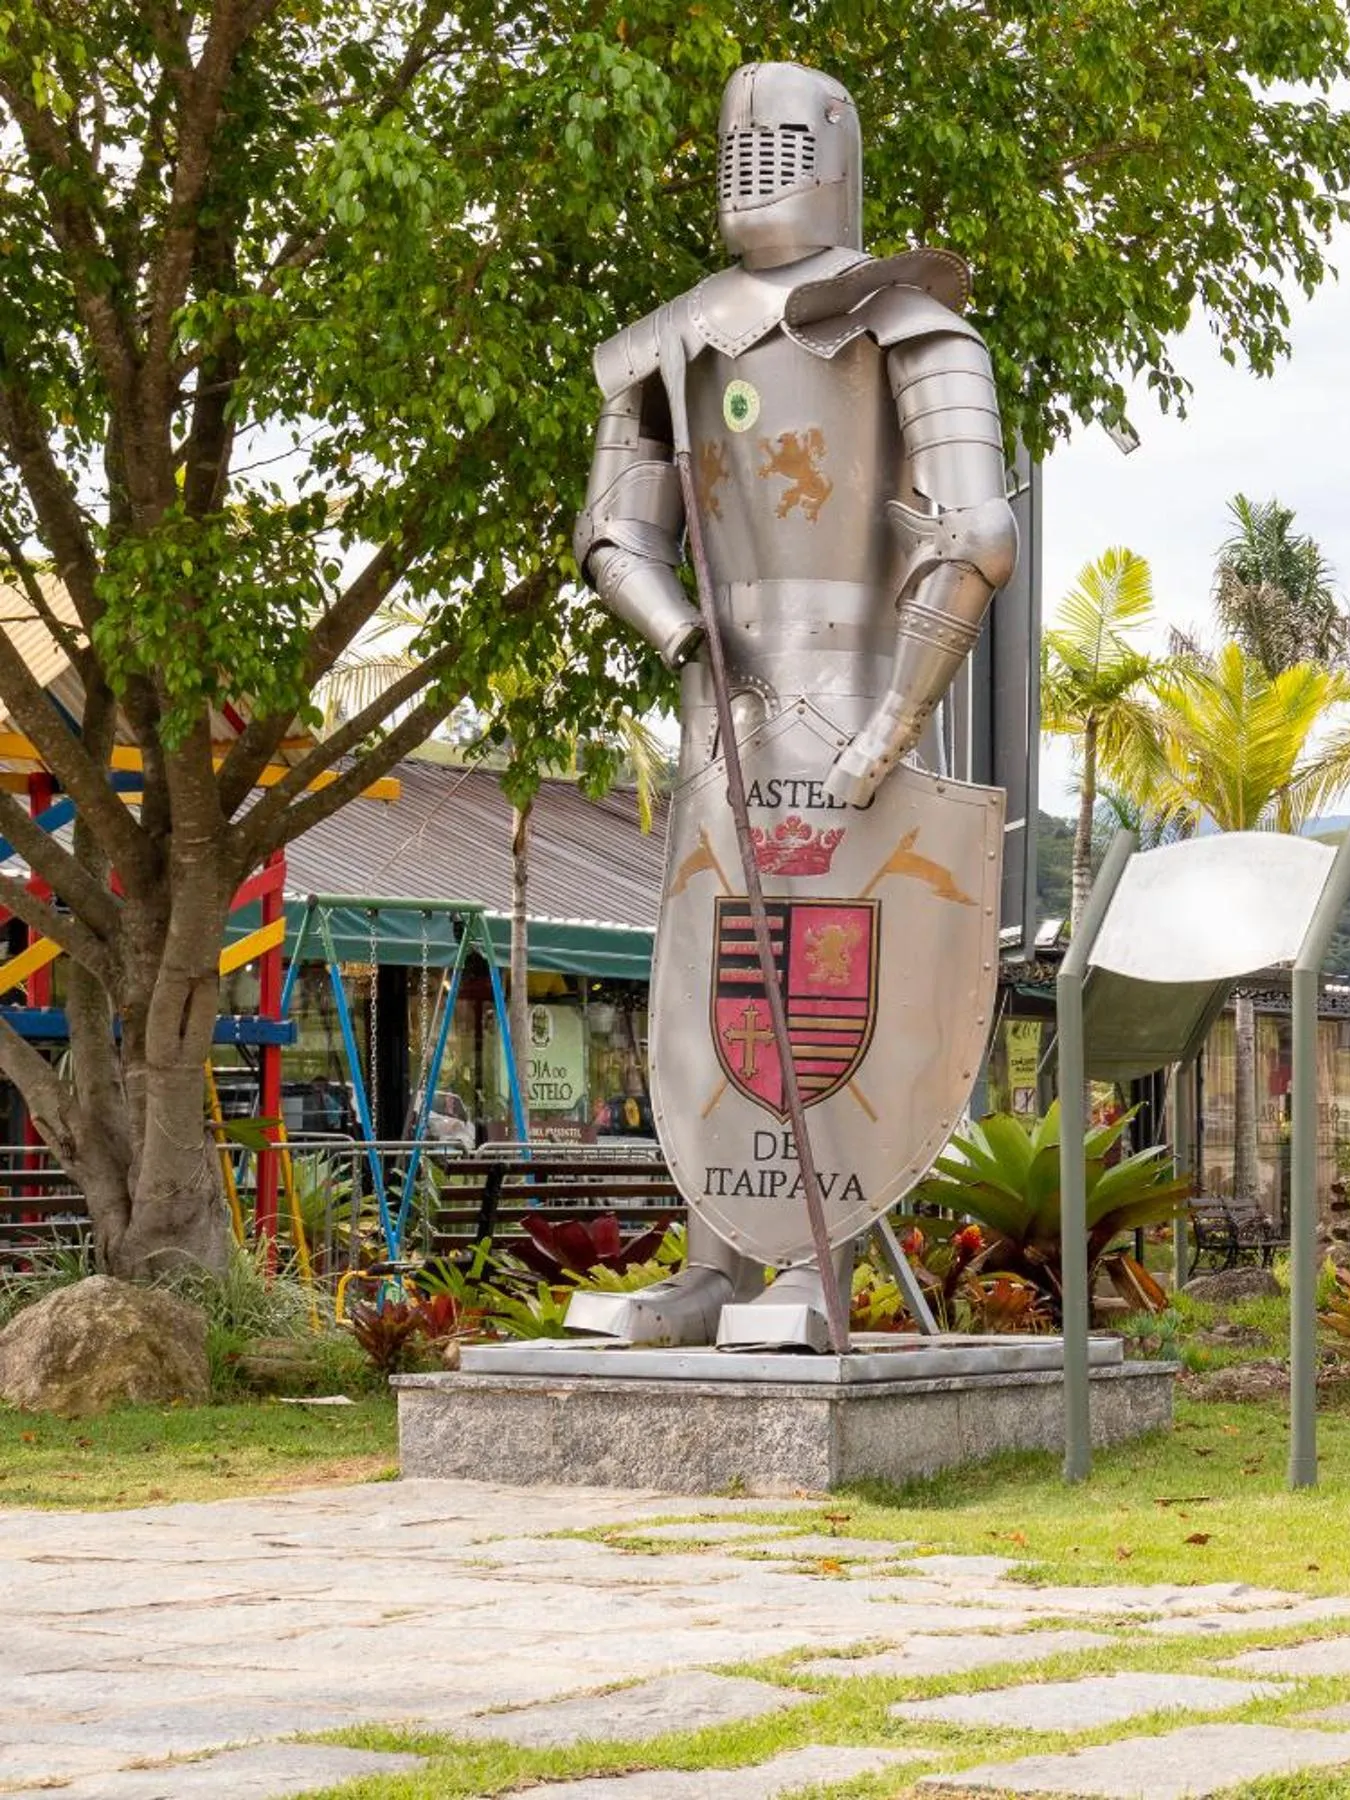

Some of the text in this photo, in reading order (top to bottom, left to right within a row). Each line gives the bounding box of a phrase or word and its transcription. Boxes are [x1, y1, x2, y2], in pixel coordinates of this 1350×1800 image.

[526, 1058, 551, 1080] OJA
[528, 1082, 573, 1101] STELO
[754, 1130, 800, 1162] DE
